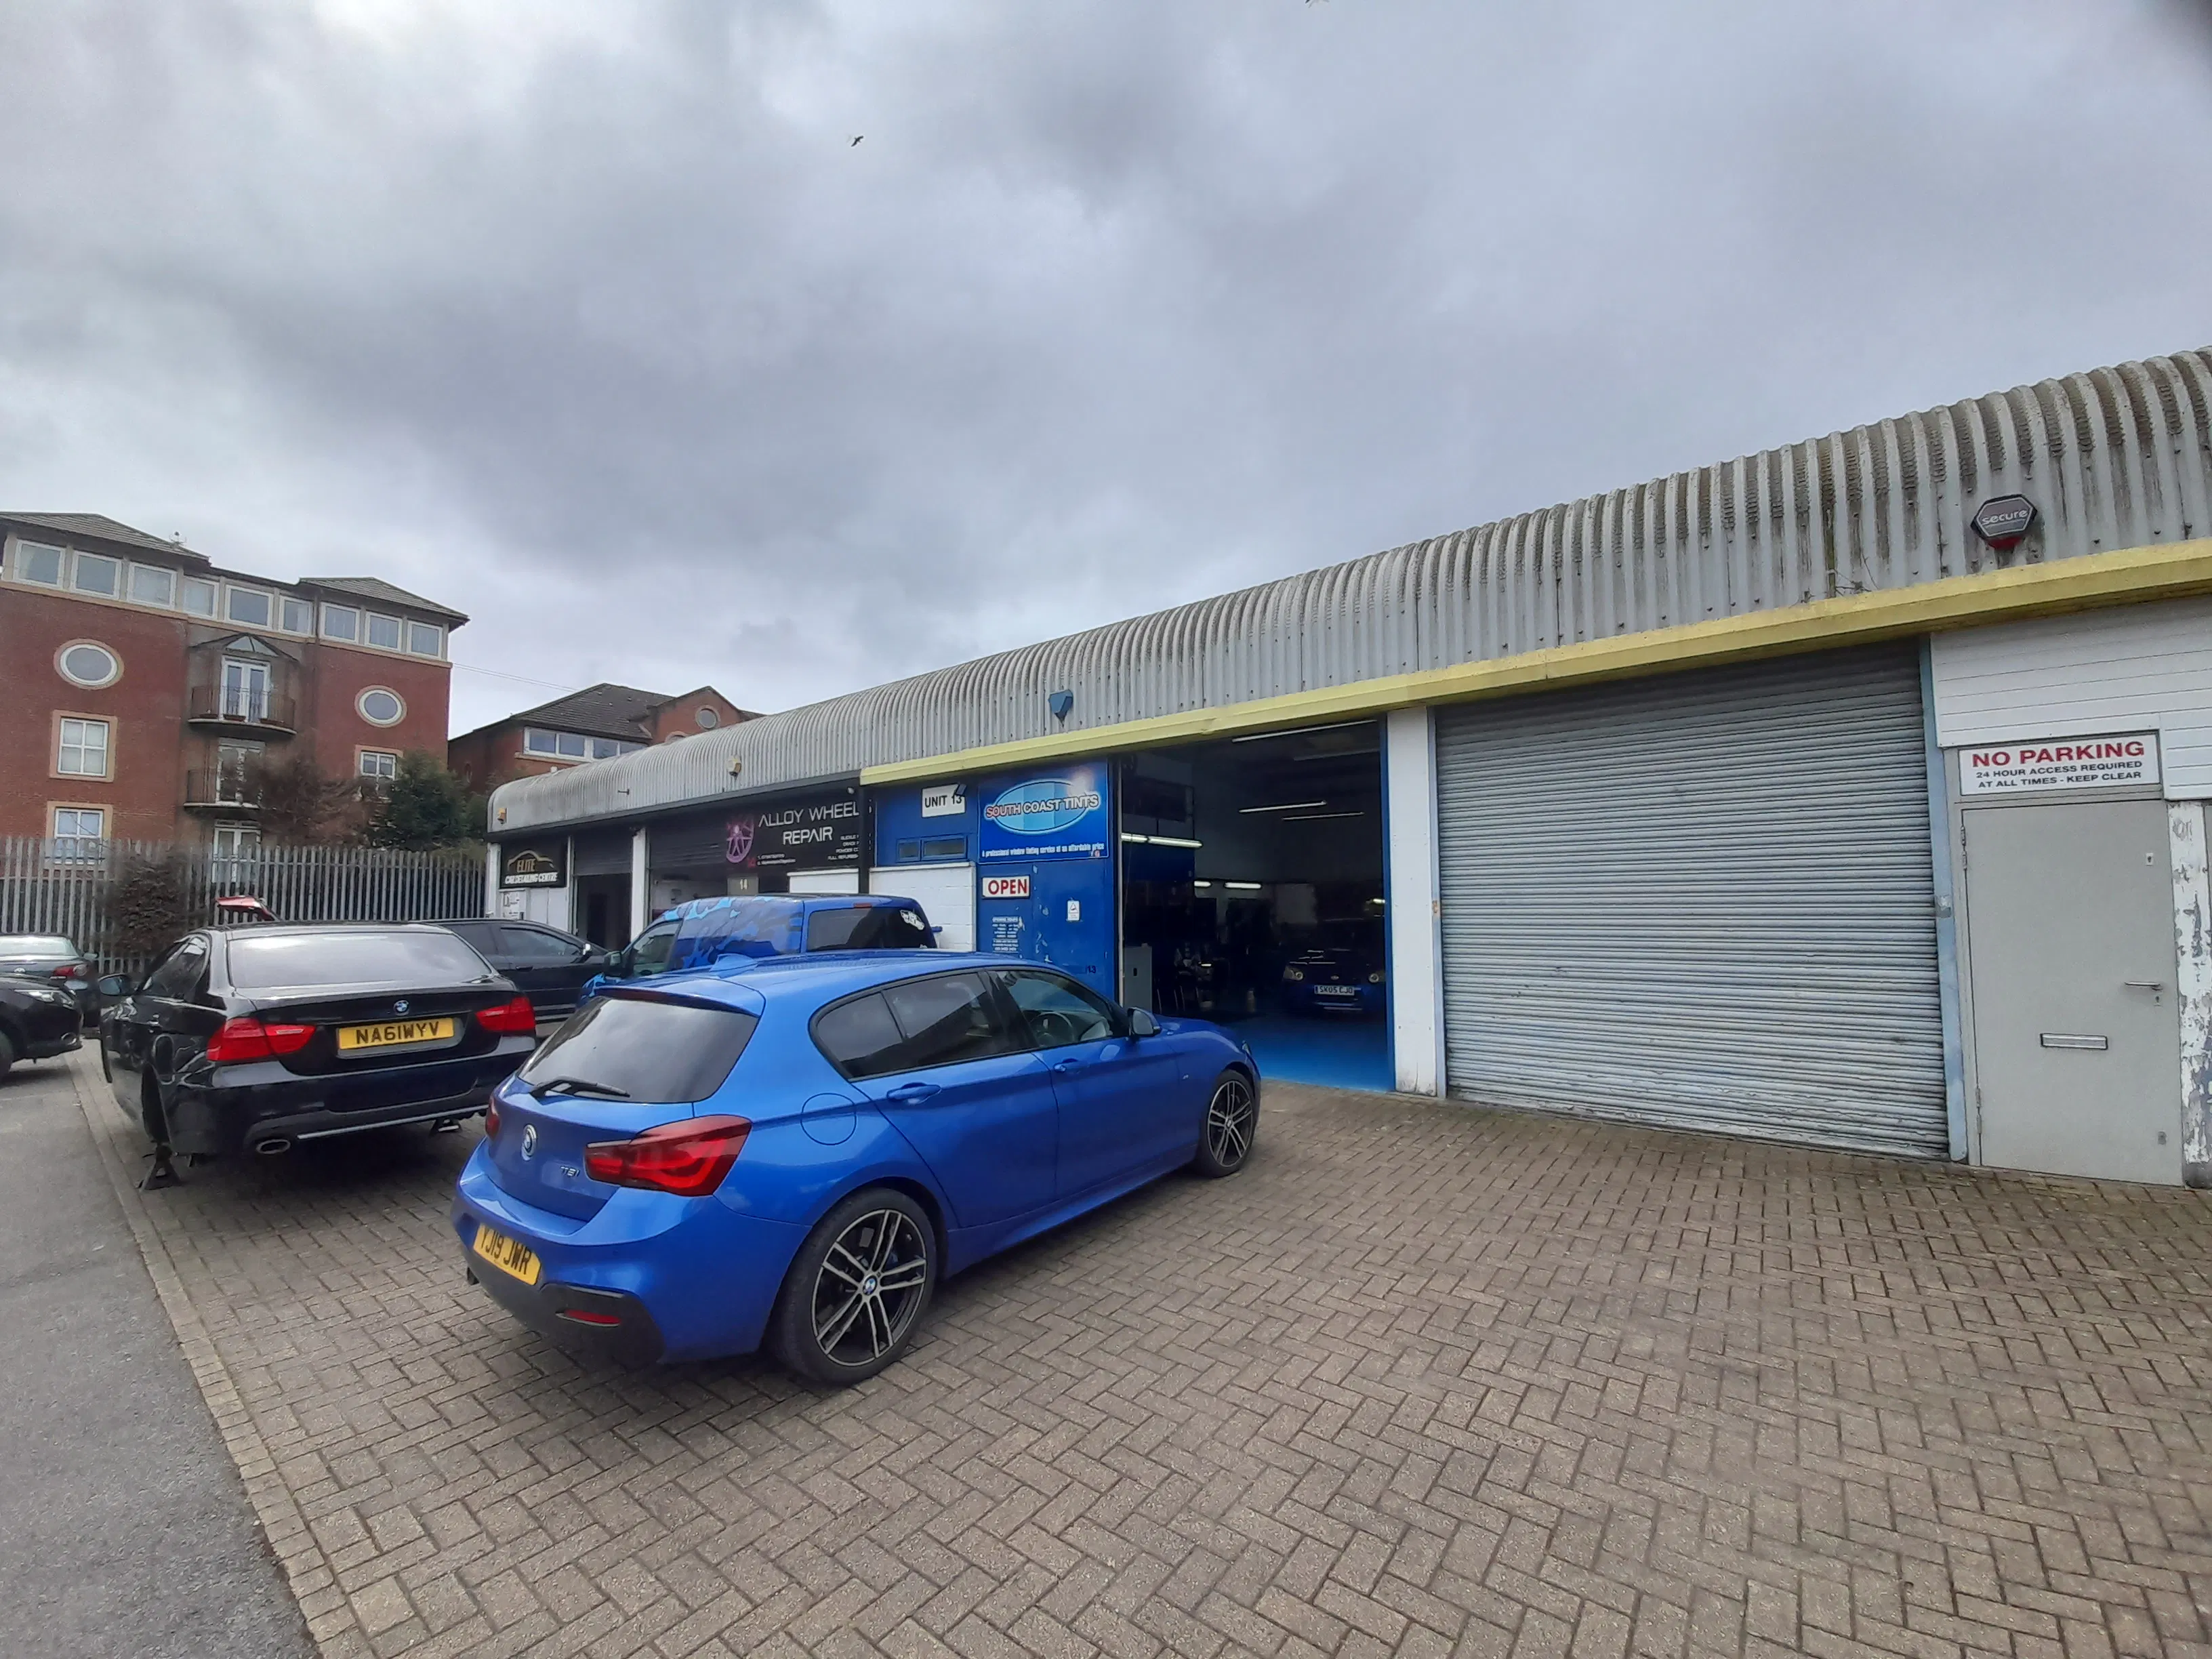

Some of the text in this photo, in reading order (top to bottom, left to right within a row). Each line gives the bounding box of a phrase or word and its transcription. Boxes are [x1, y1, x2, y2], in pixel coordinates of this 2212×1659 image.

[1982, 510, 2028, 526] secure
[1972, 741, 2145, 767] NO PARKING
[1993, 769, 2026, 777] HOUR
[2030, 766, 2077, 775] ACCESS
[2081, 760, 2143, 771] REQUIRED
[1996, 779, 2018, 787] ALL
[2021, 777, 2057, 785] TIMES
[2066, 775, 2098, 783] KEEP
[2102, 771, 2142, 780] CLEAR
[924, 795, 947, 808] UNIT
[986, 794, 1099, 818] SOUTH COAST TINTS
[758, 808, 804, 827] ALLOY
[783, 826, 833, 846] REPAIR
[987, 879, 1027, 895] OPEN
[503, 1240, 532, 1275] JWR
